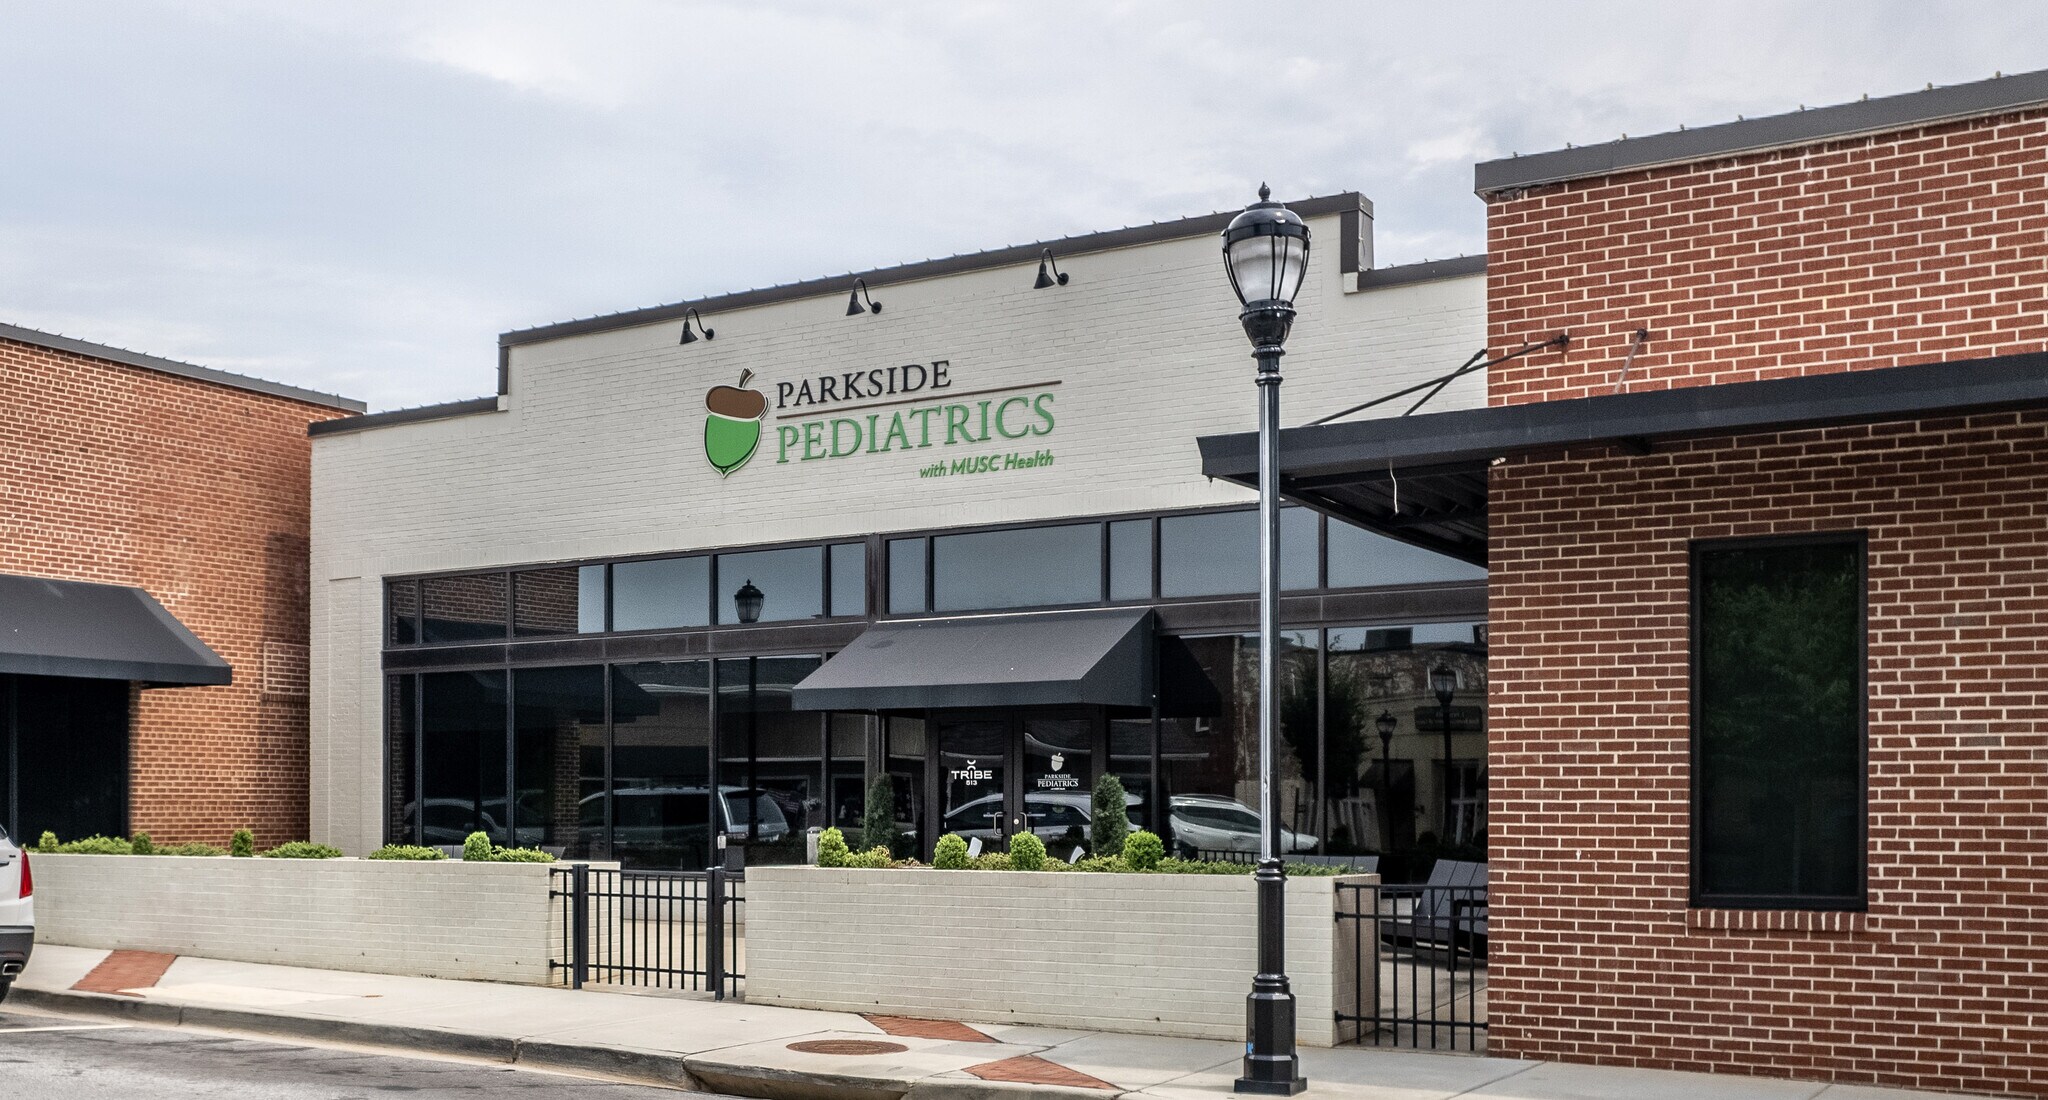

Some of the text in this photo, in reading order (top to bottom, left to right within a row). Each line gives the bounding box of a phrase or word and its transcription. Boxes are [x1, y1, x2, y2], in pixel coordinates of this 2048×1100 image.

[776, 360, 952, 409] PARKSIDE
[776, 393, 1056, 464] PEDIATRICS
[919, 449, 1055, 478] with MUSC Health
[951, 770, 993, 780] TRIBE
[1037, 780, 1079, 788] PEDIATRICS
